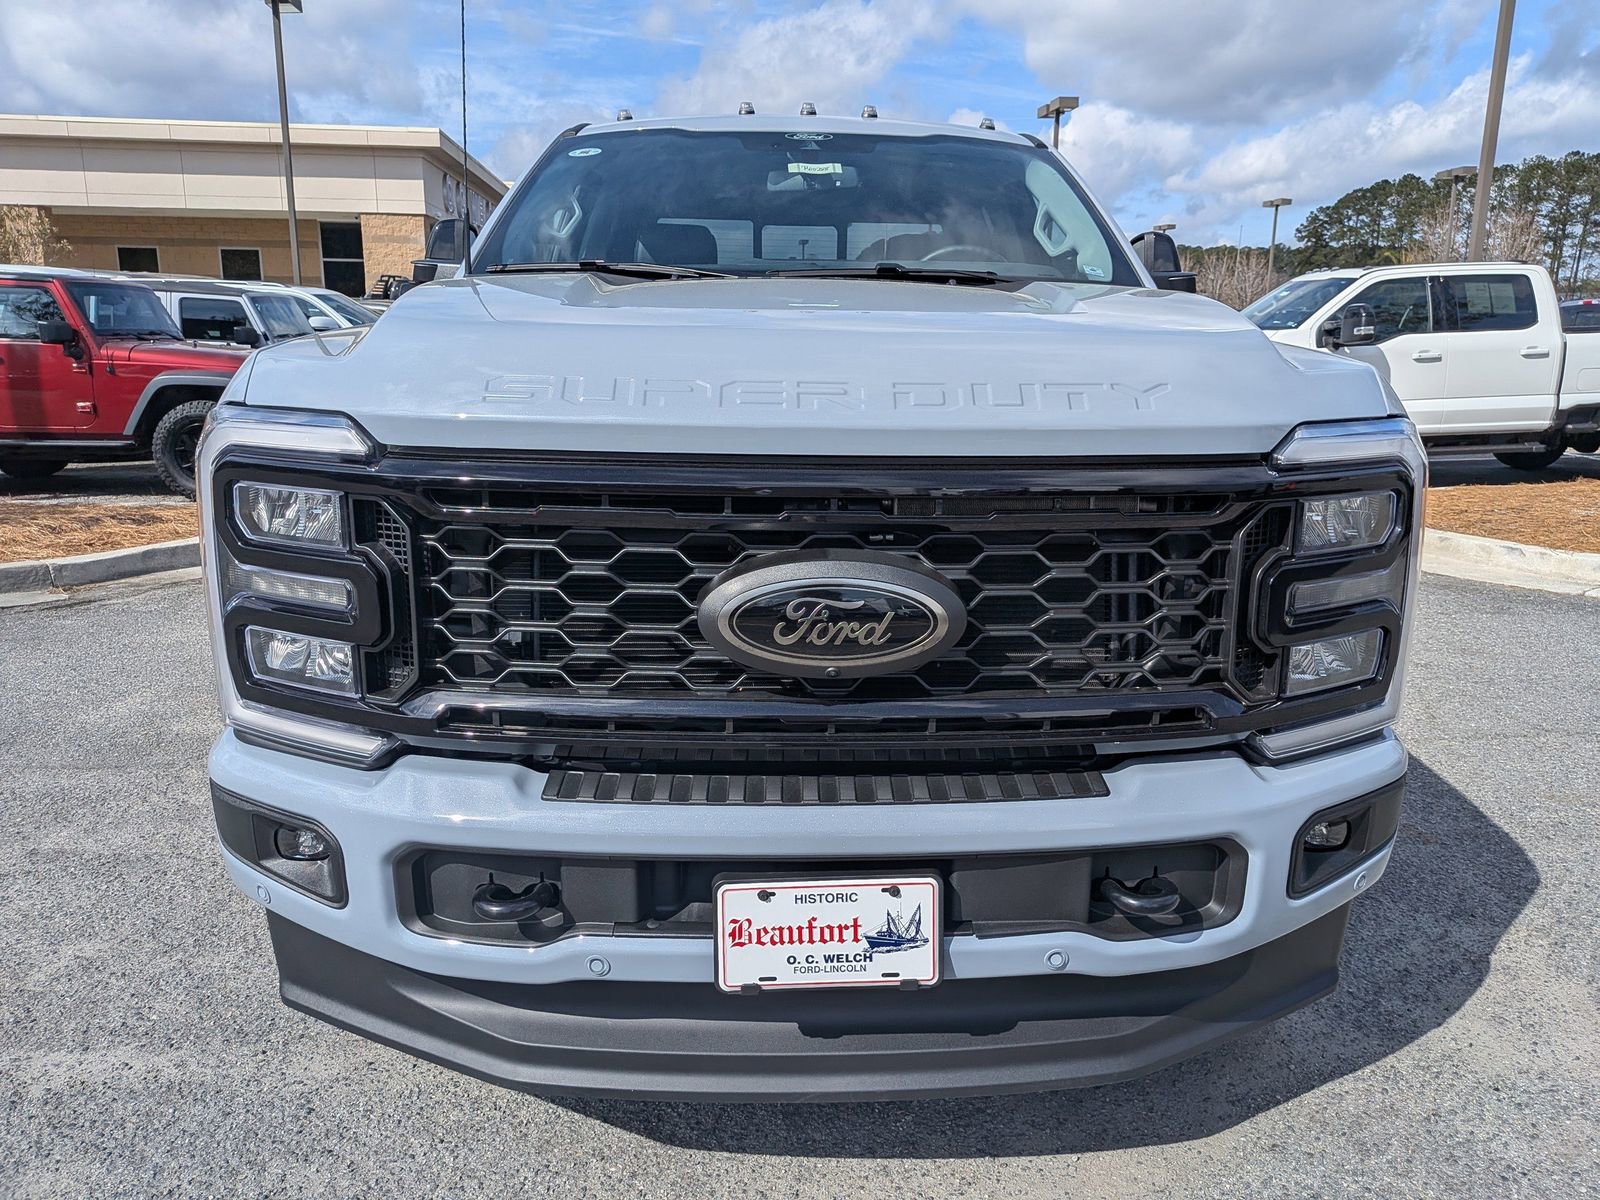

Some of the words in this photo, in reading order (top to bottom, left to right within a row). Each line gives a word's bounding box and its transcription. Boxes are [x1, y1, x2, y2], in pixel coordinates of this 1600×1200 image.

[482, 375, 864, 409] SUPER
[892, 382, 1172, 411] DUTY
[773, 597, 895, 646] Ford
[794, 892, 859, 905] HISTORIC
[728, 916, 863, 949] Beaufort
[786, 955, 801, 965] O.
[805, 954, 819, 964] C.
[823, 952, 873, 964] WELCH
[793, 964, 867, 974] FORD-LINCOLN
